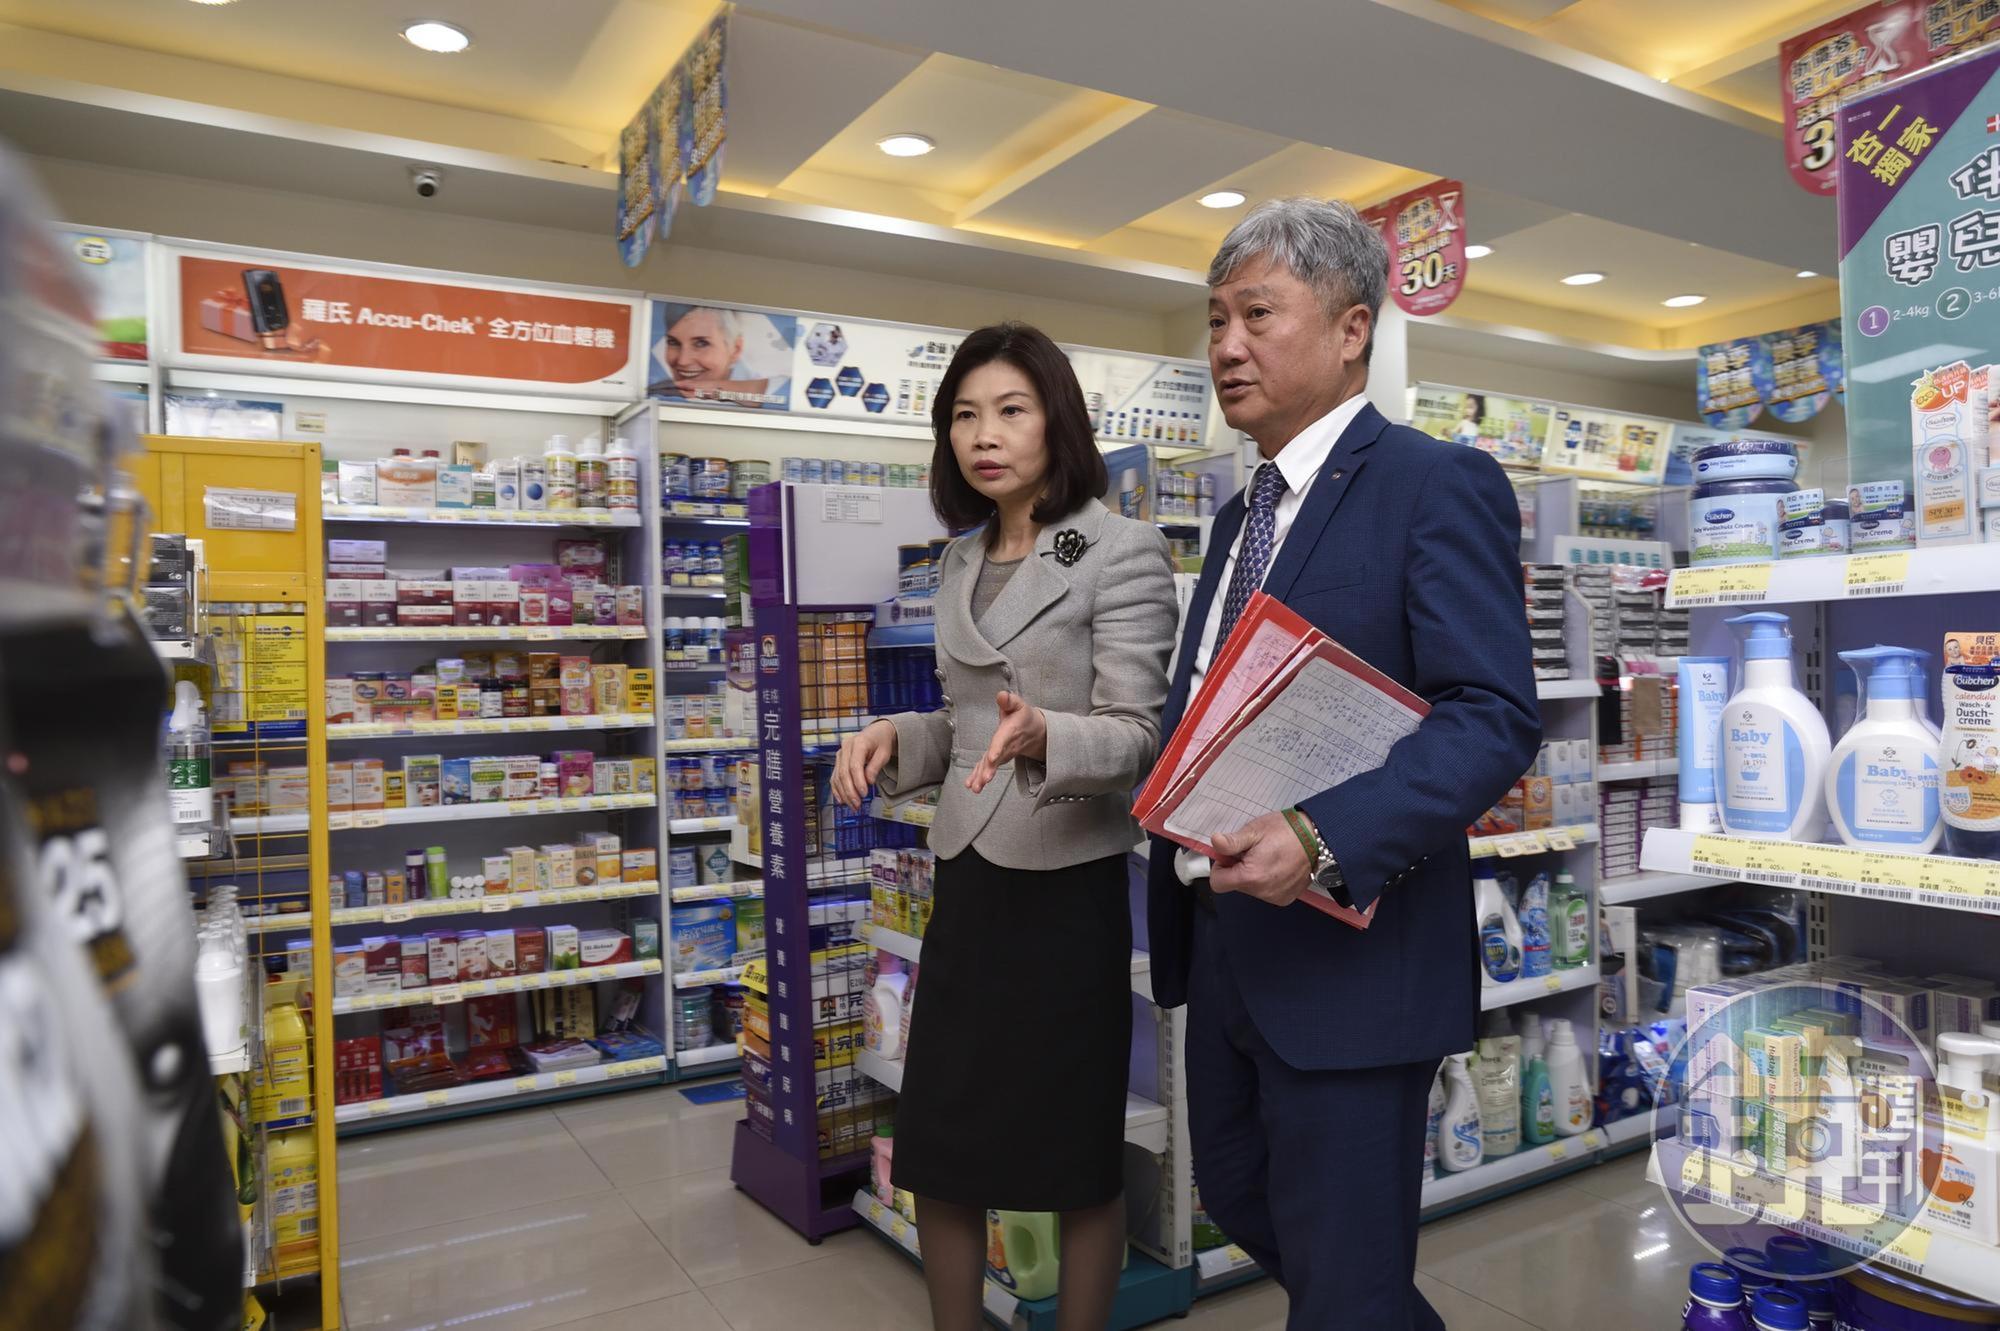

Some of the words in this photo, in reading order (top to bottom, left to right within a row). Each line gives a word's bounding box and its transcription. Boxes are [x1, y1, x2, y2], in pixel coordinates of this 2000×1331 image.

[1845, 104, 1901, 166] 杏一
[1870, 115, 1938, 187] 獨家
[1892, 305, 1929, 322] 2-4kg
[302, 298, 352, 325] 羅氏
[357, 307, 476, 335] Accu-Chek
[488, 317, 615, 349] 全方位血糖機
[1941, 381, 1966, 398] UP
[1956, 674, 1995, 685] Bübchen
[1697, 690, 1727, 704] Baby
[1955, 692, 1996, 701] calendula
[1956, 708, 1994, 717] Dusch-
[1958, 717, 1991, 725] creme
[1731, 728, 1771, 745] Baby
[764, 711, 785, 879] 完膳營養素
